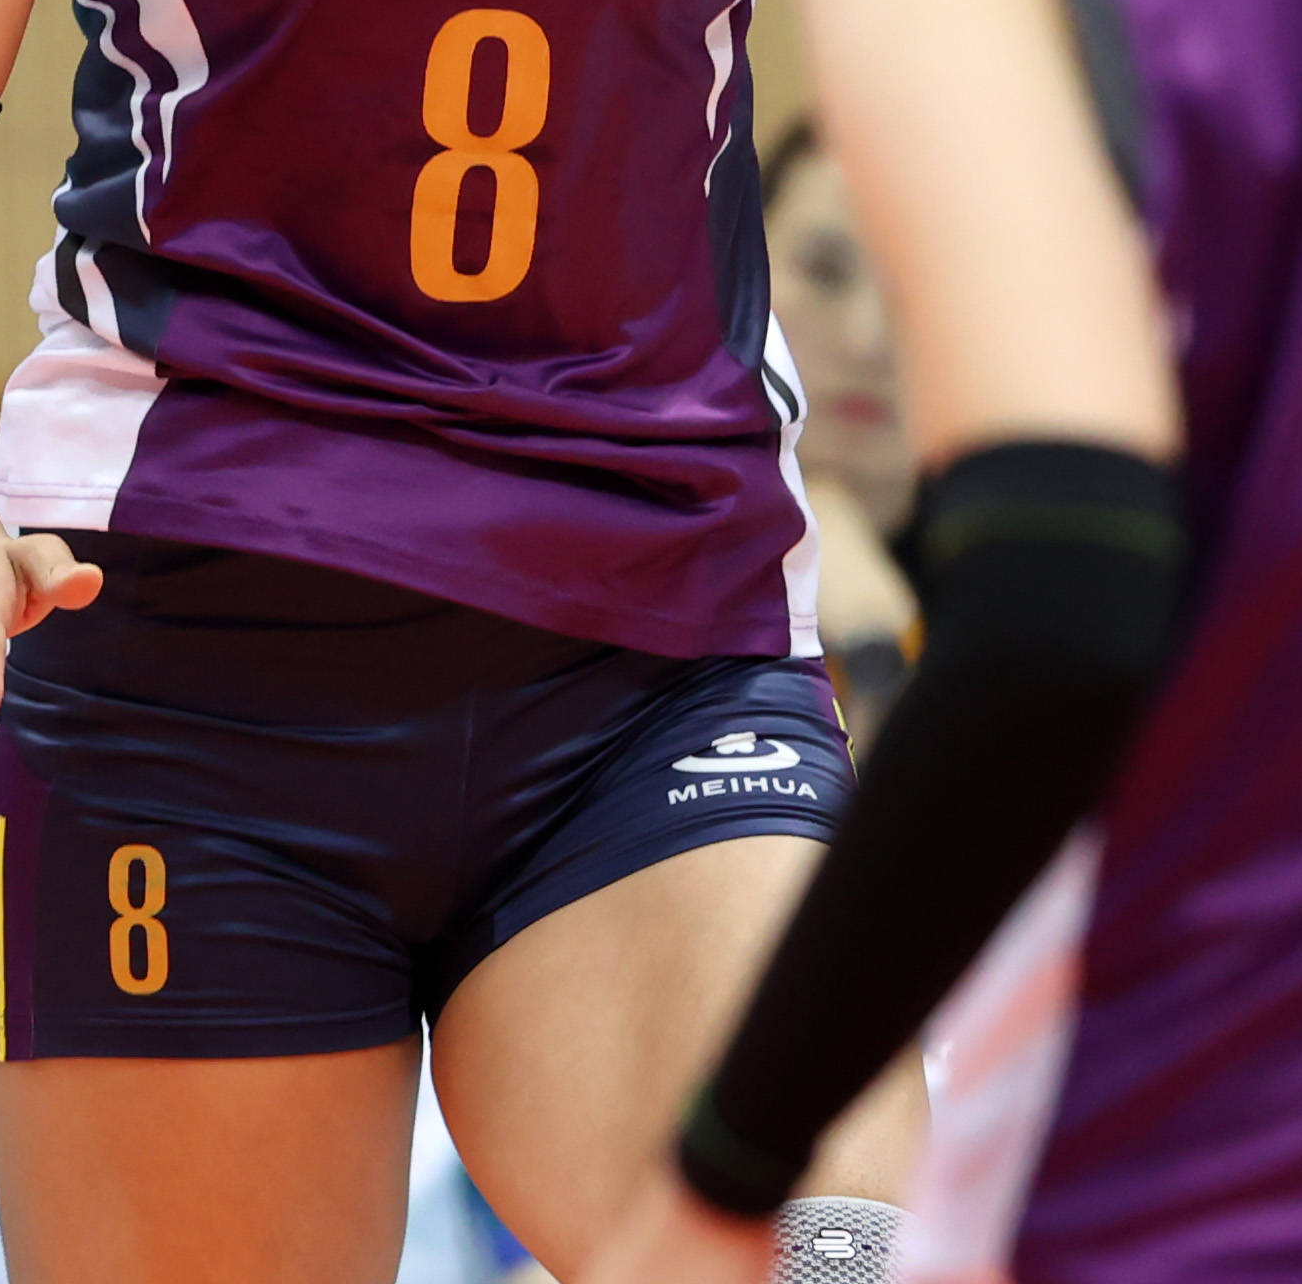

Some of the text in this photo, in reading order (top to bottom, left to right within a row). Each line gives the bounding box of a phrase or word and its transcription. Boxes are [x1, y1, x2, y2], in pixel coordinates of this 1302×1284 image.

[409, 8, 551, 302] 8
[667, 776, 819, 806] MEIHUA
[107, 844, 169, 996] 8
